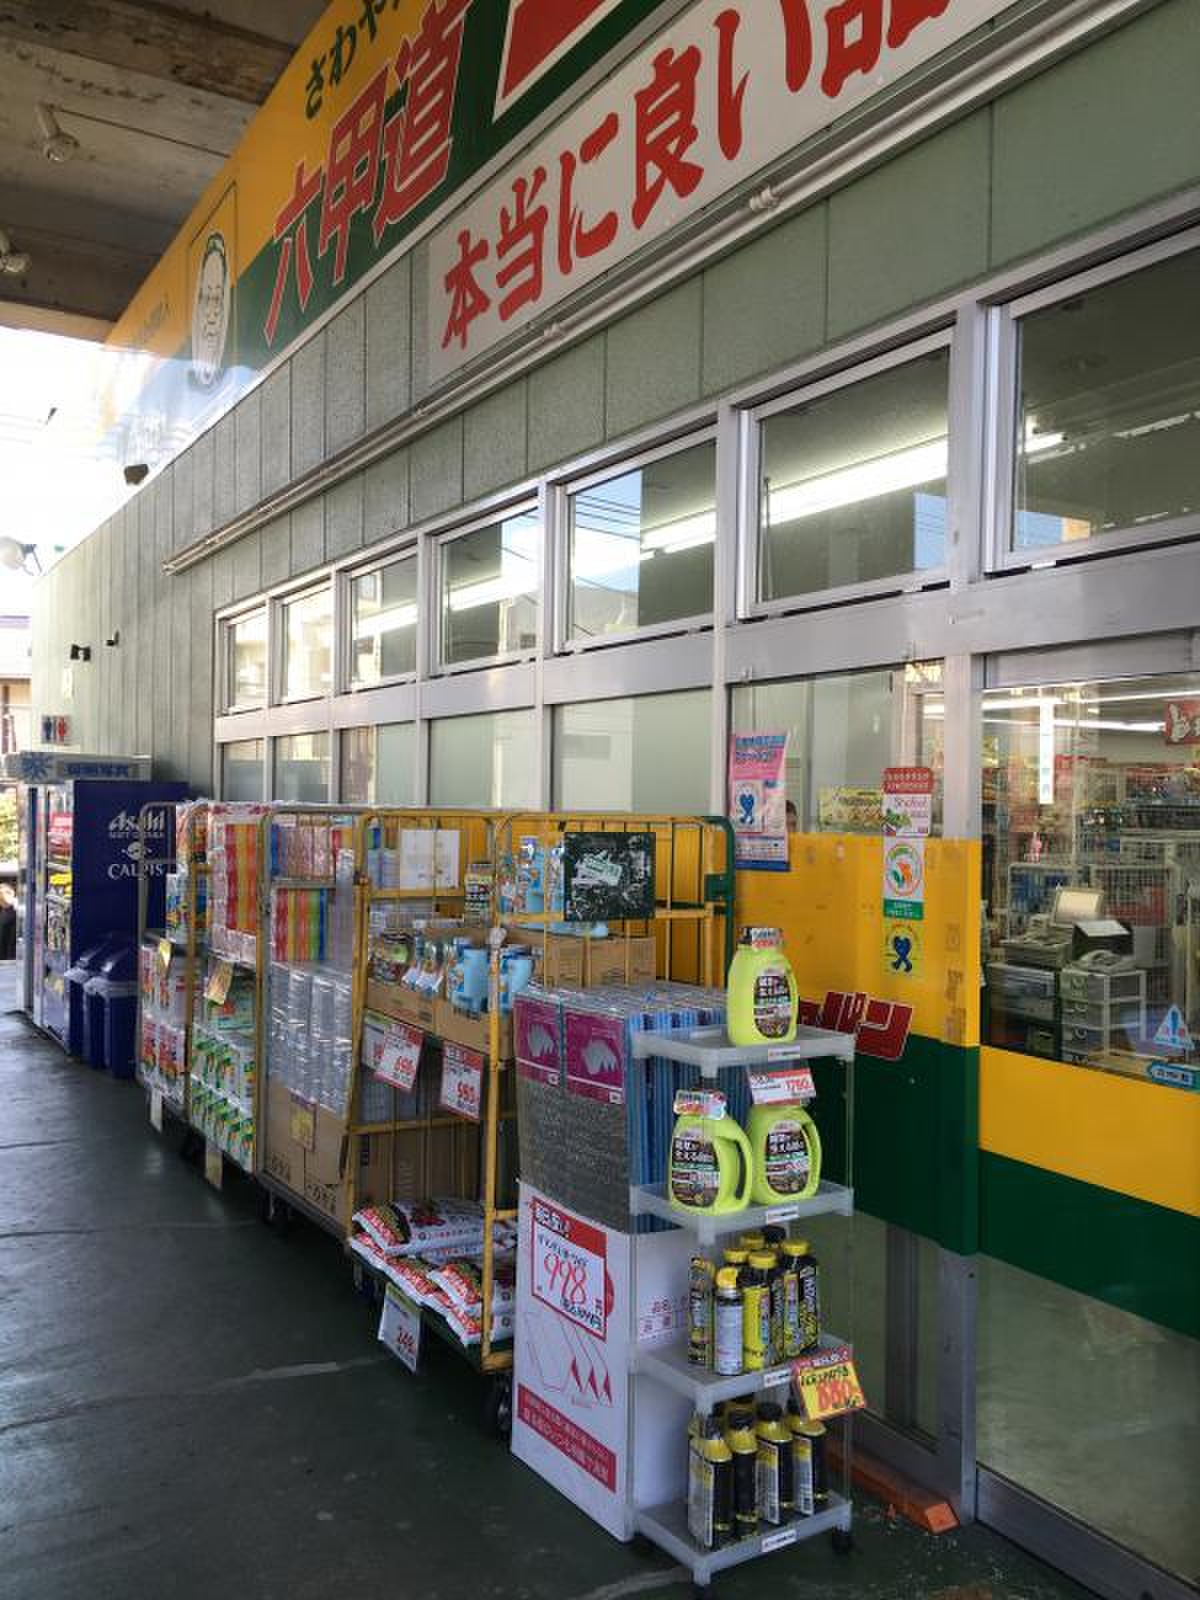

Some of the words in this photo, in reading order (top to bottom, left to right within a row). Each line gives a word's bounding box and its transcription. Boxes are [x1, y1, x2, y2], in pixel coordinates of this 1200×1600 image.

[261, 0, 472, 348] 六甲道
[543, 1252, 587, 1305] 998
